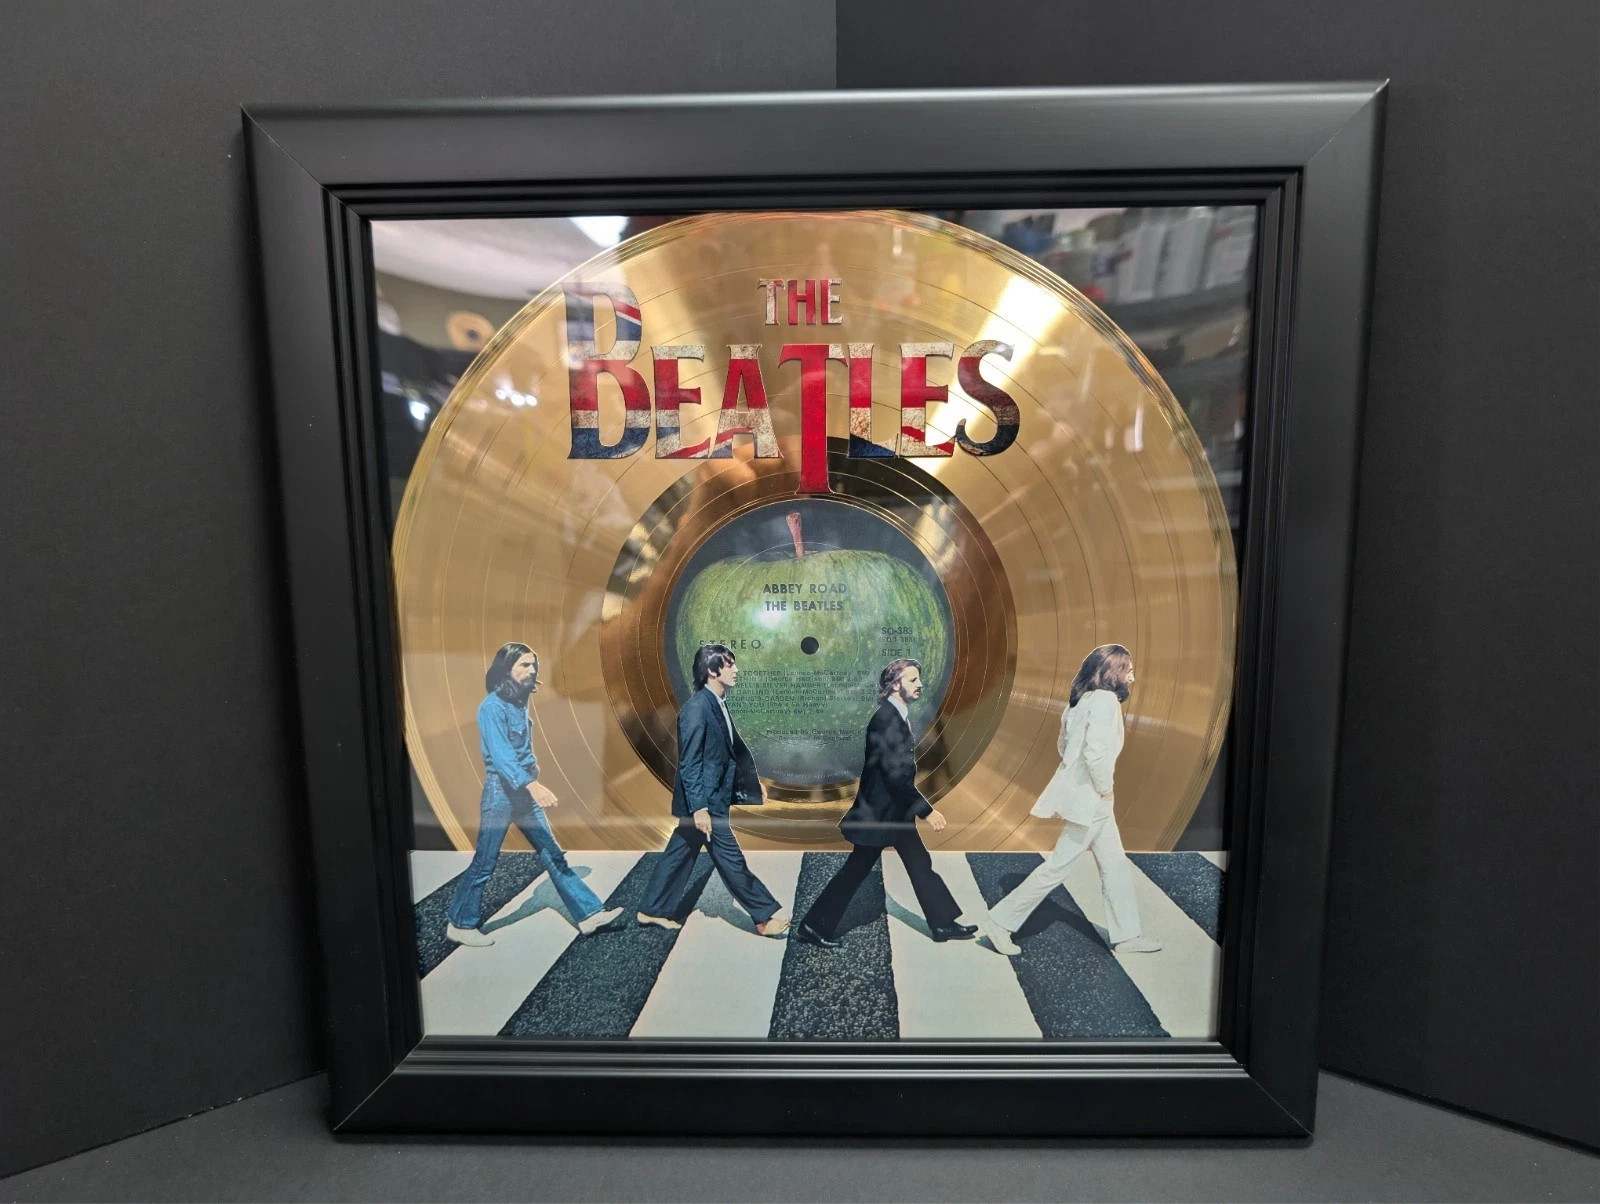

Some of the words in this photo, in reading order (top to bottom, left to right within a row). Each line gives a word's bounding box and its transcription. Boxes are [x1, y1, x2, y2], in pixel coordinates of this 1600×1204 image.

[757, 278, 844, 326] THE
[563, 281, 1021, 495] BEATLES
[763, 583, 803, 594] ABBEY
[809, 583, 848, 594] ROAD
[765, 600, 787, 611] THE
[793, 600, 844, 611] BEATLES
[881, 626, 913, 636] SO-383
[881, 648, 903, 657] SIDE
[905, 647, 911, 657] 1
